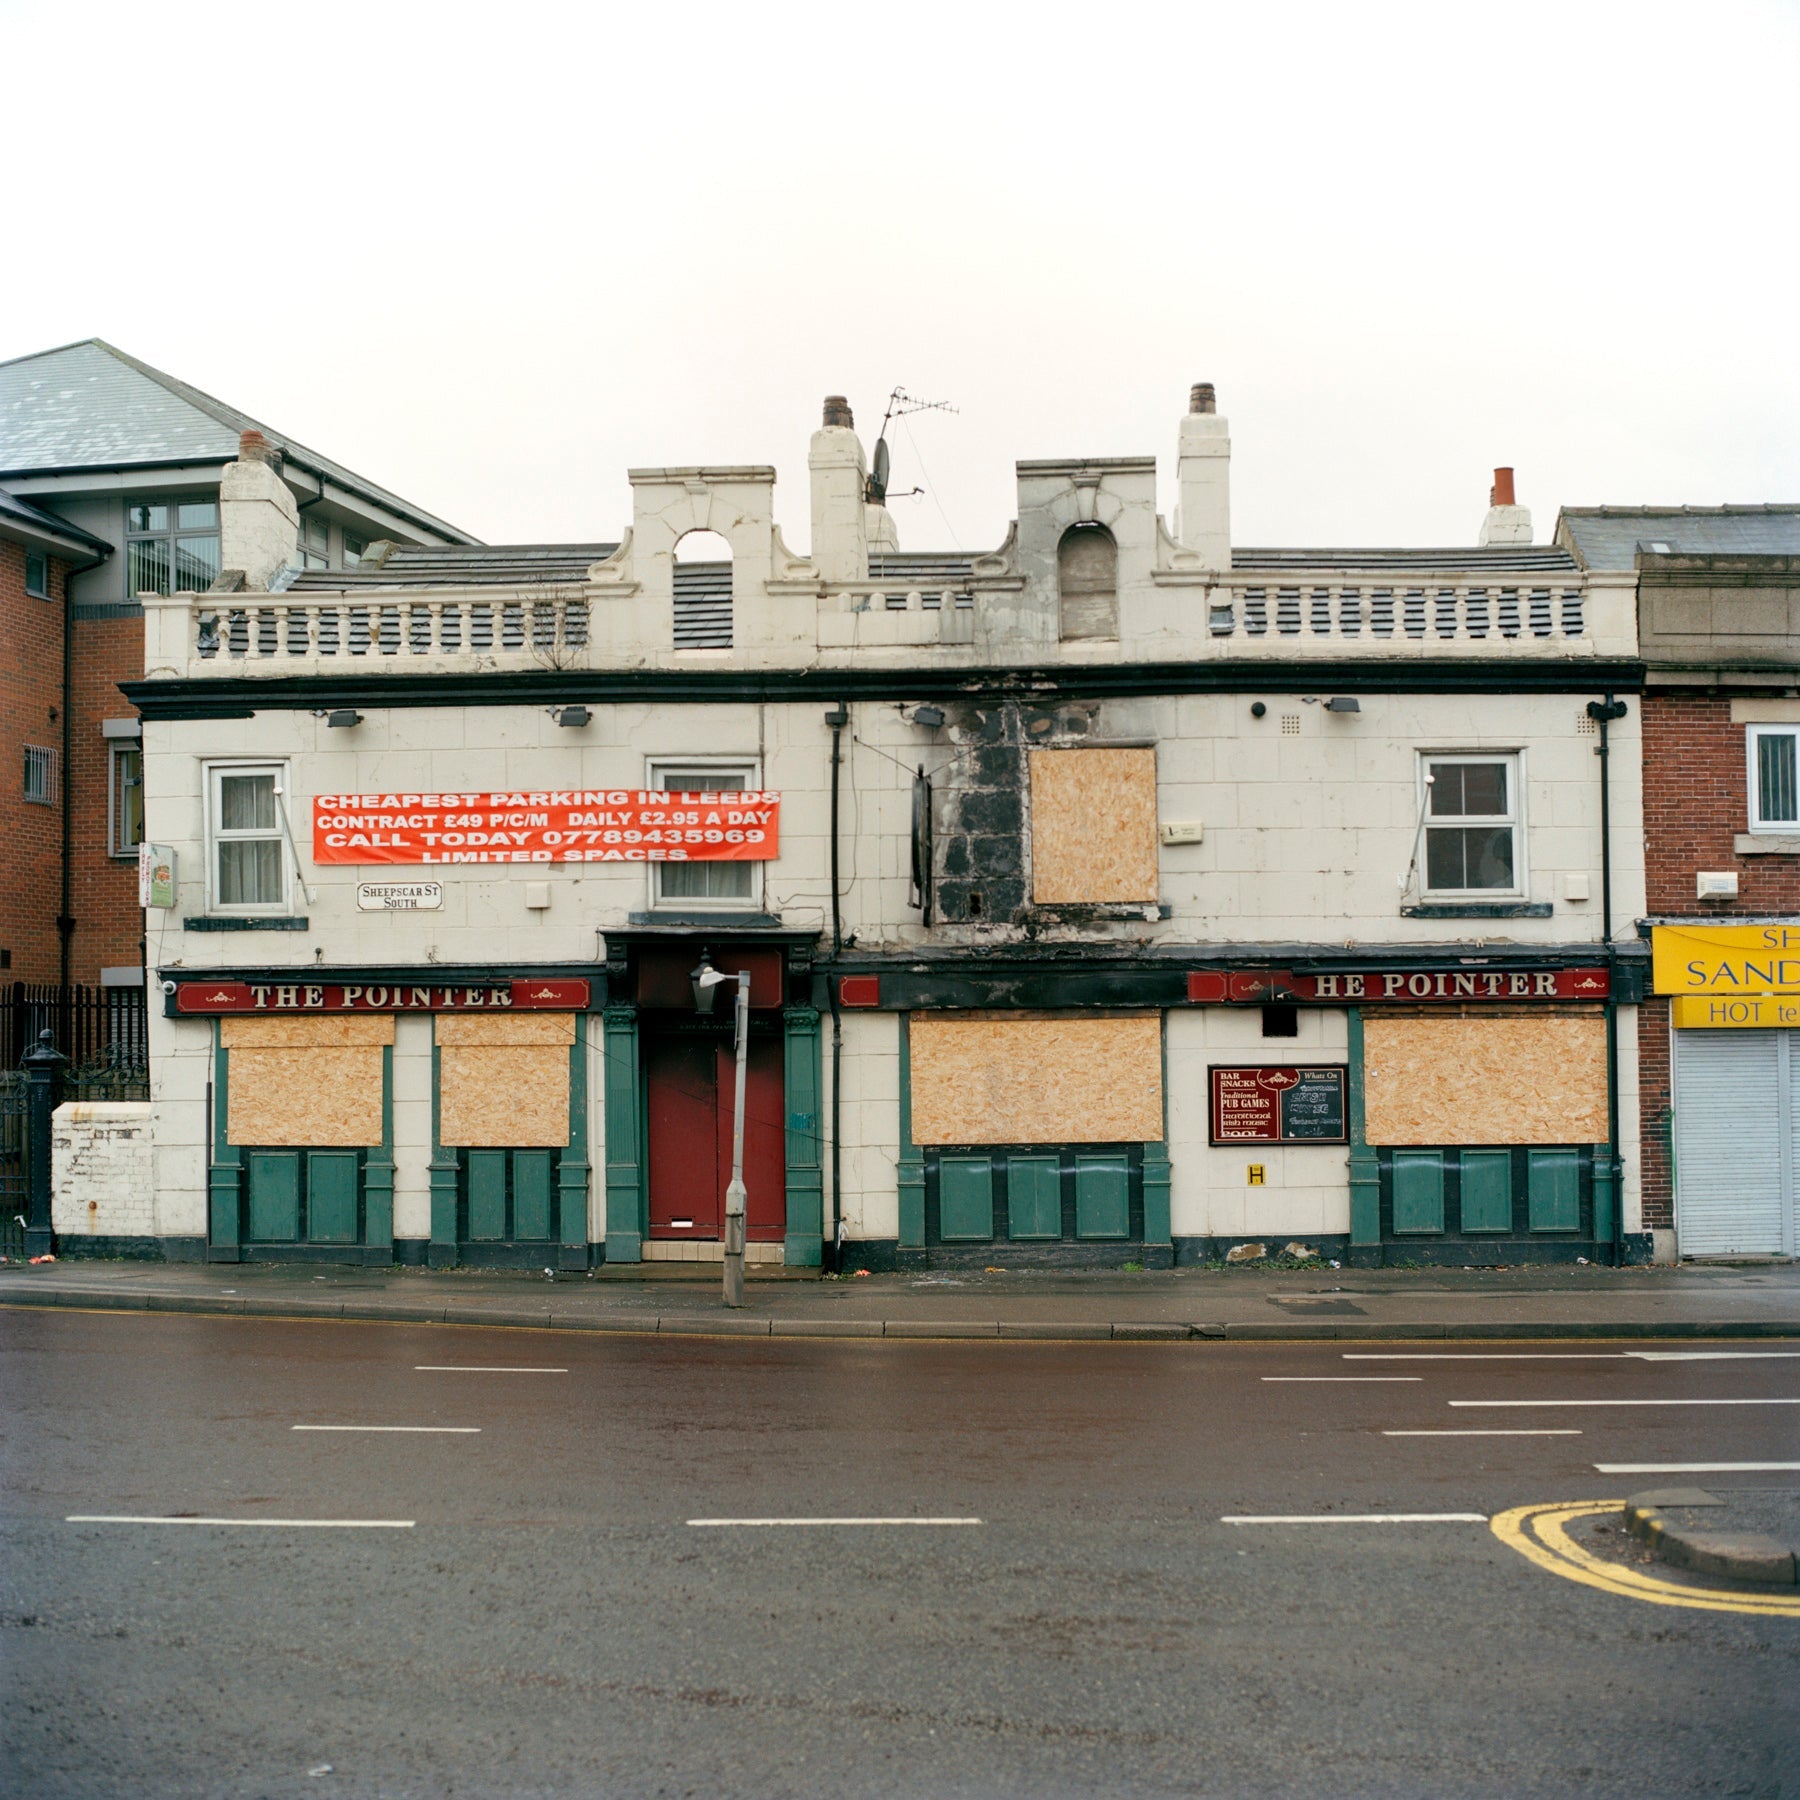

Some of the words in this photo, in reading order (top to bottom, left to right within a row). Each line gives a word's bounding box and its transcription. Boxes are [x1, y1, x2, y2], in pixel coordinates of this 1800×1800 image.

[317, 793, 480, 809] CHEAPEST
[489, 791, 628, 806] PARKING
[638, 791, 670, 805] IN
[681, 791, 780, 805] LEEDS
[317, 814, 438, 829] CONTRACT
[444, 813, 483, 828] £49
[489, 813, 548, 827] P/C/M
[568, 811, 633, 826] DAILY
[639, 811, 699, 825] £2.95
[705, 811, 721, 825] A
[728, 811, 772, 825] DAY
[325, 833, 411, 847] CALL
[420, 831, 533, 846] TODAY
[542, 829, 765, 844] 07789435969
[422, 851, 553, 863] LIMITED
[563, 849, 688, 861] SPACES
[1687, 960, 1800, 986] SAND
[1382, 972, 1558, 997] POINTER
[251, 985, 324, 1008] THE
[341, 985, 512, 1007] POINTER
[1709, 1002, 1763, 1022] HOT
[1220, 1072, 1240, 1080] BAR
[1220, 1080, 1256, 1088] SNACKS
[1326, 1071, 1338, 1079] On
[1222, 1099, 1239, 1109] PUB
[1240, 1098, 1270, 1108] GAMES
[1249, 1166, 1264, 1184] H
